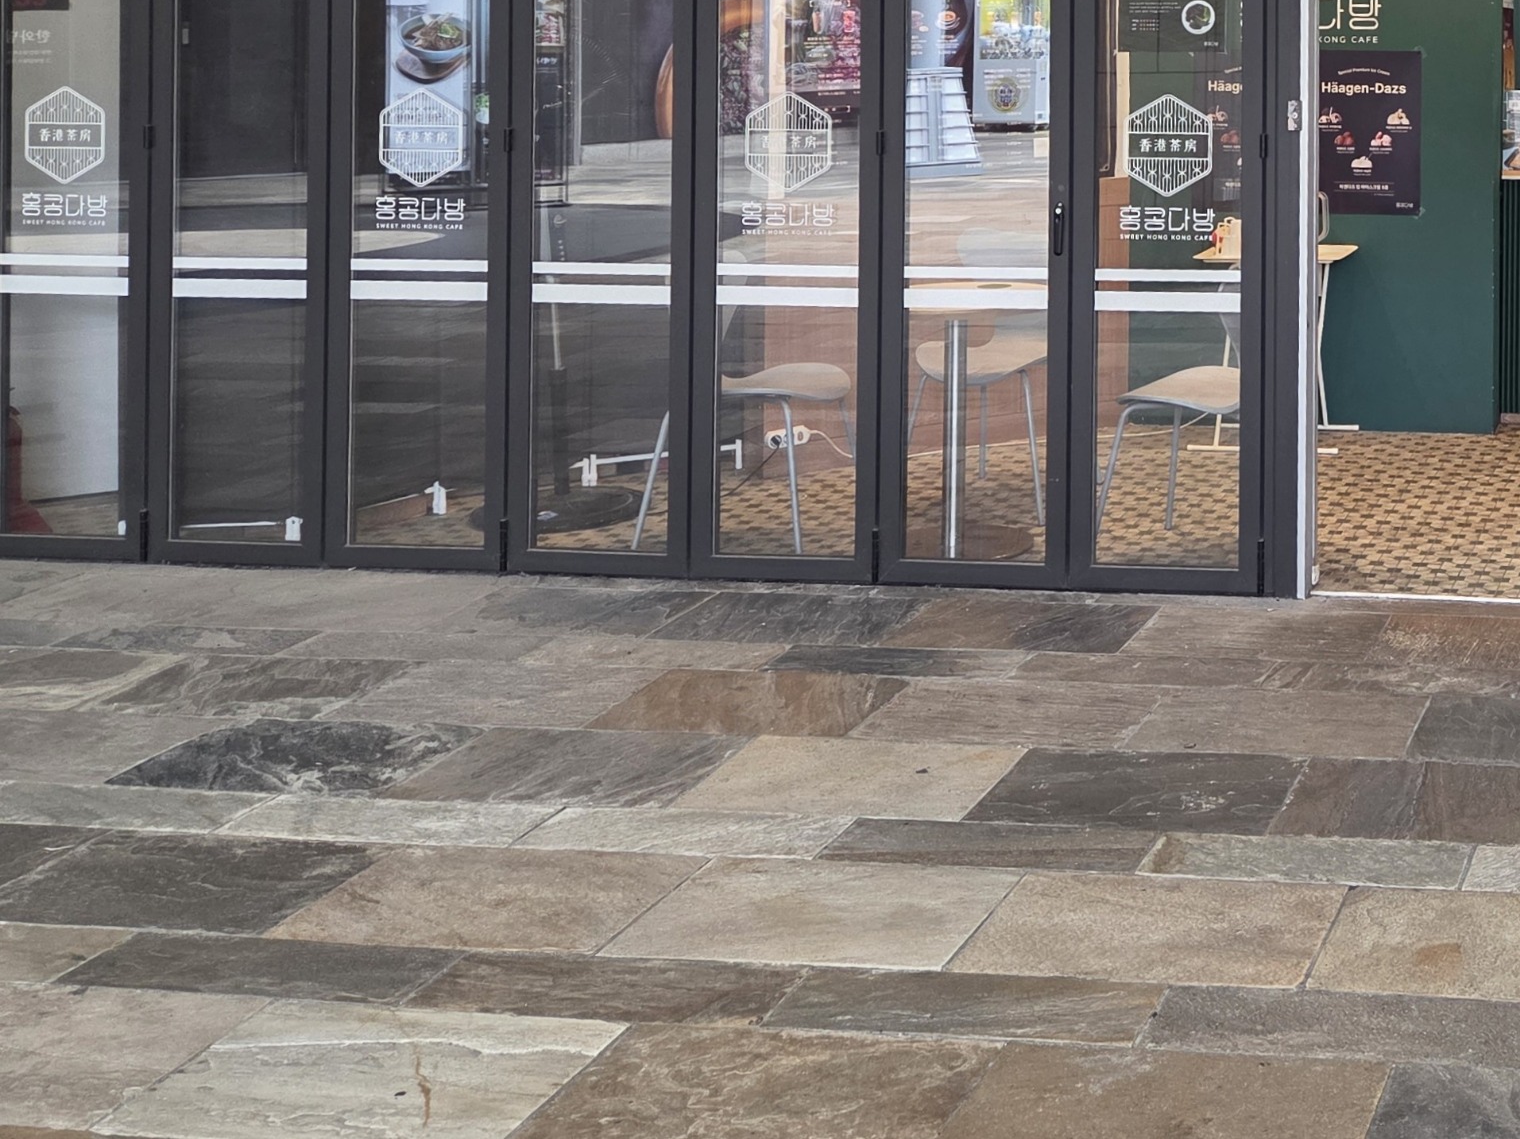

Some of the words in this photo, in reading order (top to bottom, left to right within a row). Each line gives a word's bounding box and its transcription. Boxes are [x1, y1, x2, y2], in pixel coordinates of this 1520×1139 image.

[1351, 35, 1379, 44] CAFE
[1207, 80, 1242, 95] Häag
[1321, 81, 1407, 96] Häagen-Dazs
[39, 127, 92, 143] 香港茶房
[1139, 137, 1198, 153] 香港茶房
[21, 191, 108, 217] 홍콩다방
[375, 195, 466, 221] 홍콩다방
[741, 200, 836, 227] 홍콩다방
[1119, 204, 1216, 232] 홍콩다방
